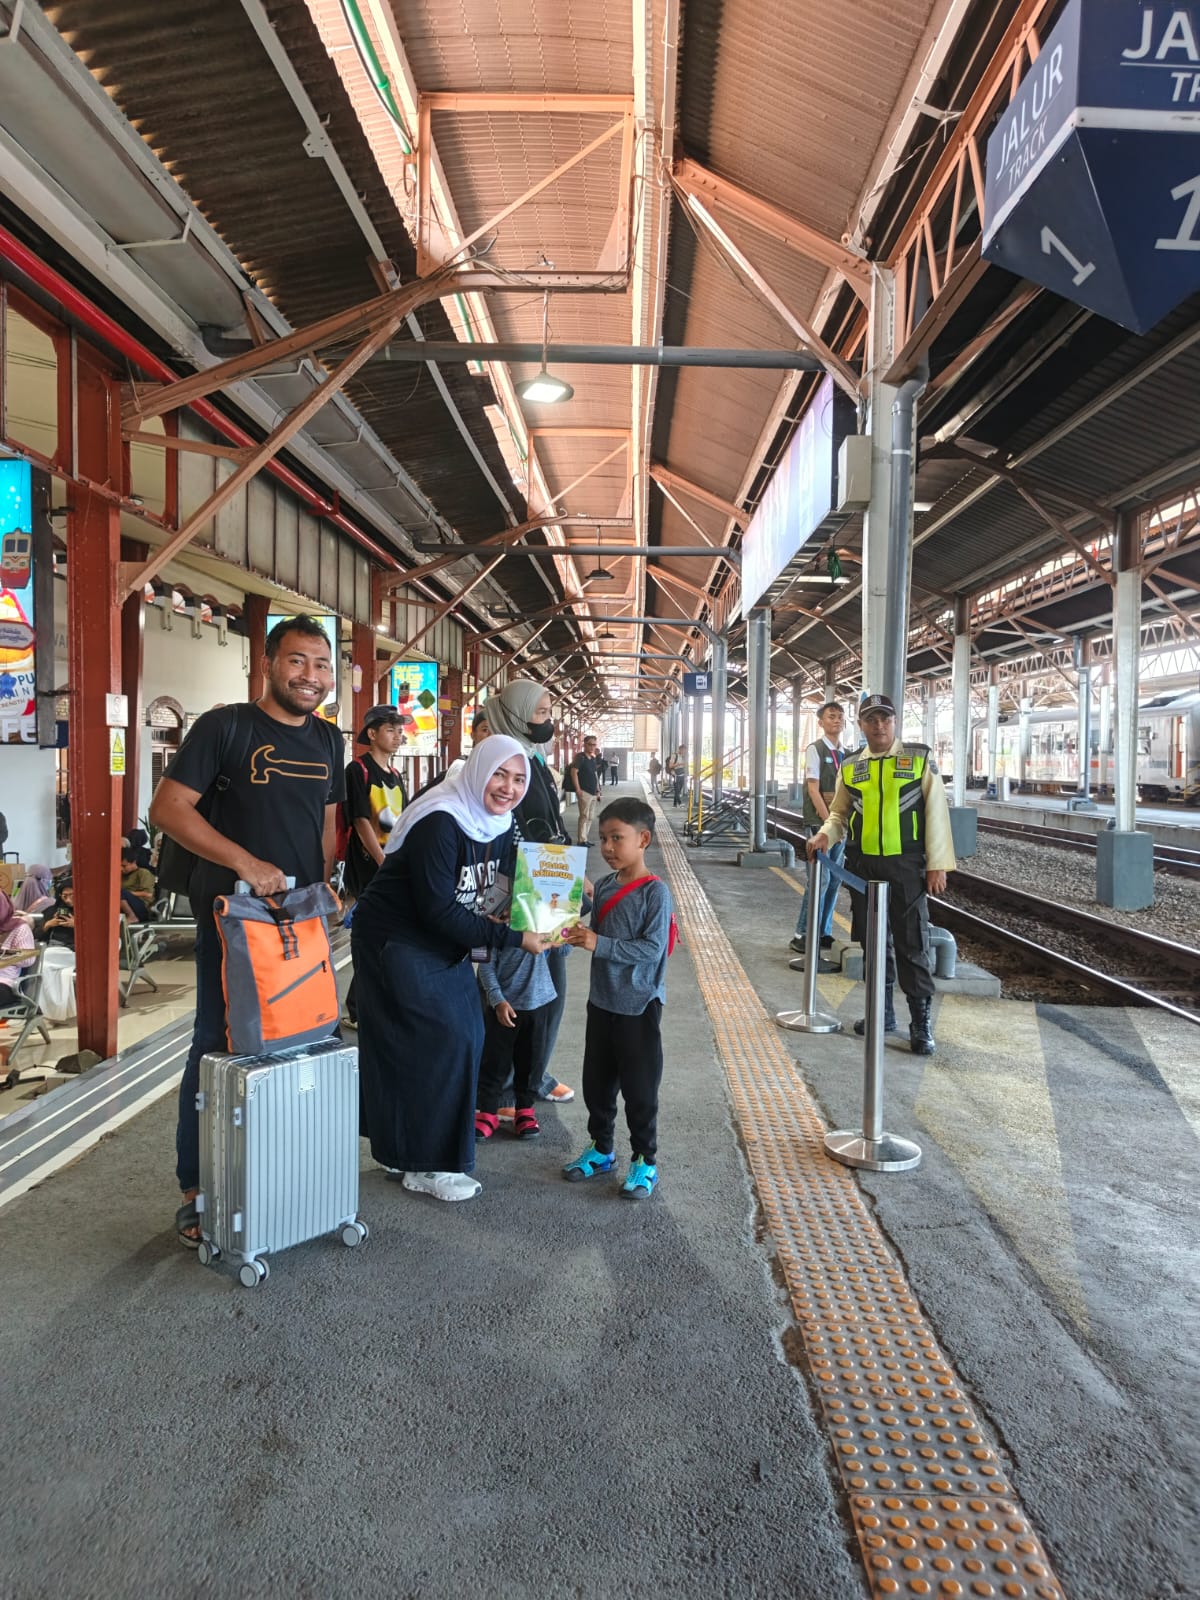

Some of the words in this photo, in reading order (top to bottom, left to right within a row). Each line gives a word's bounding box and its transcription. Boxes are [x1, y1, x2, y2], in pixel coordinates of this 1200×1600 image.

[995, 43, 1063, 180] JALUR
[1007, 119, 1048, 192] TRACK
[1040, 225, 1096, 286] 1
